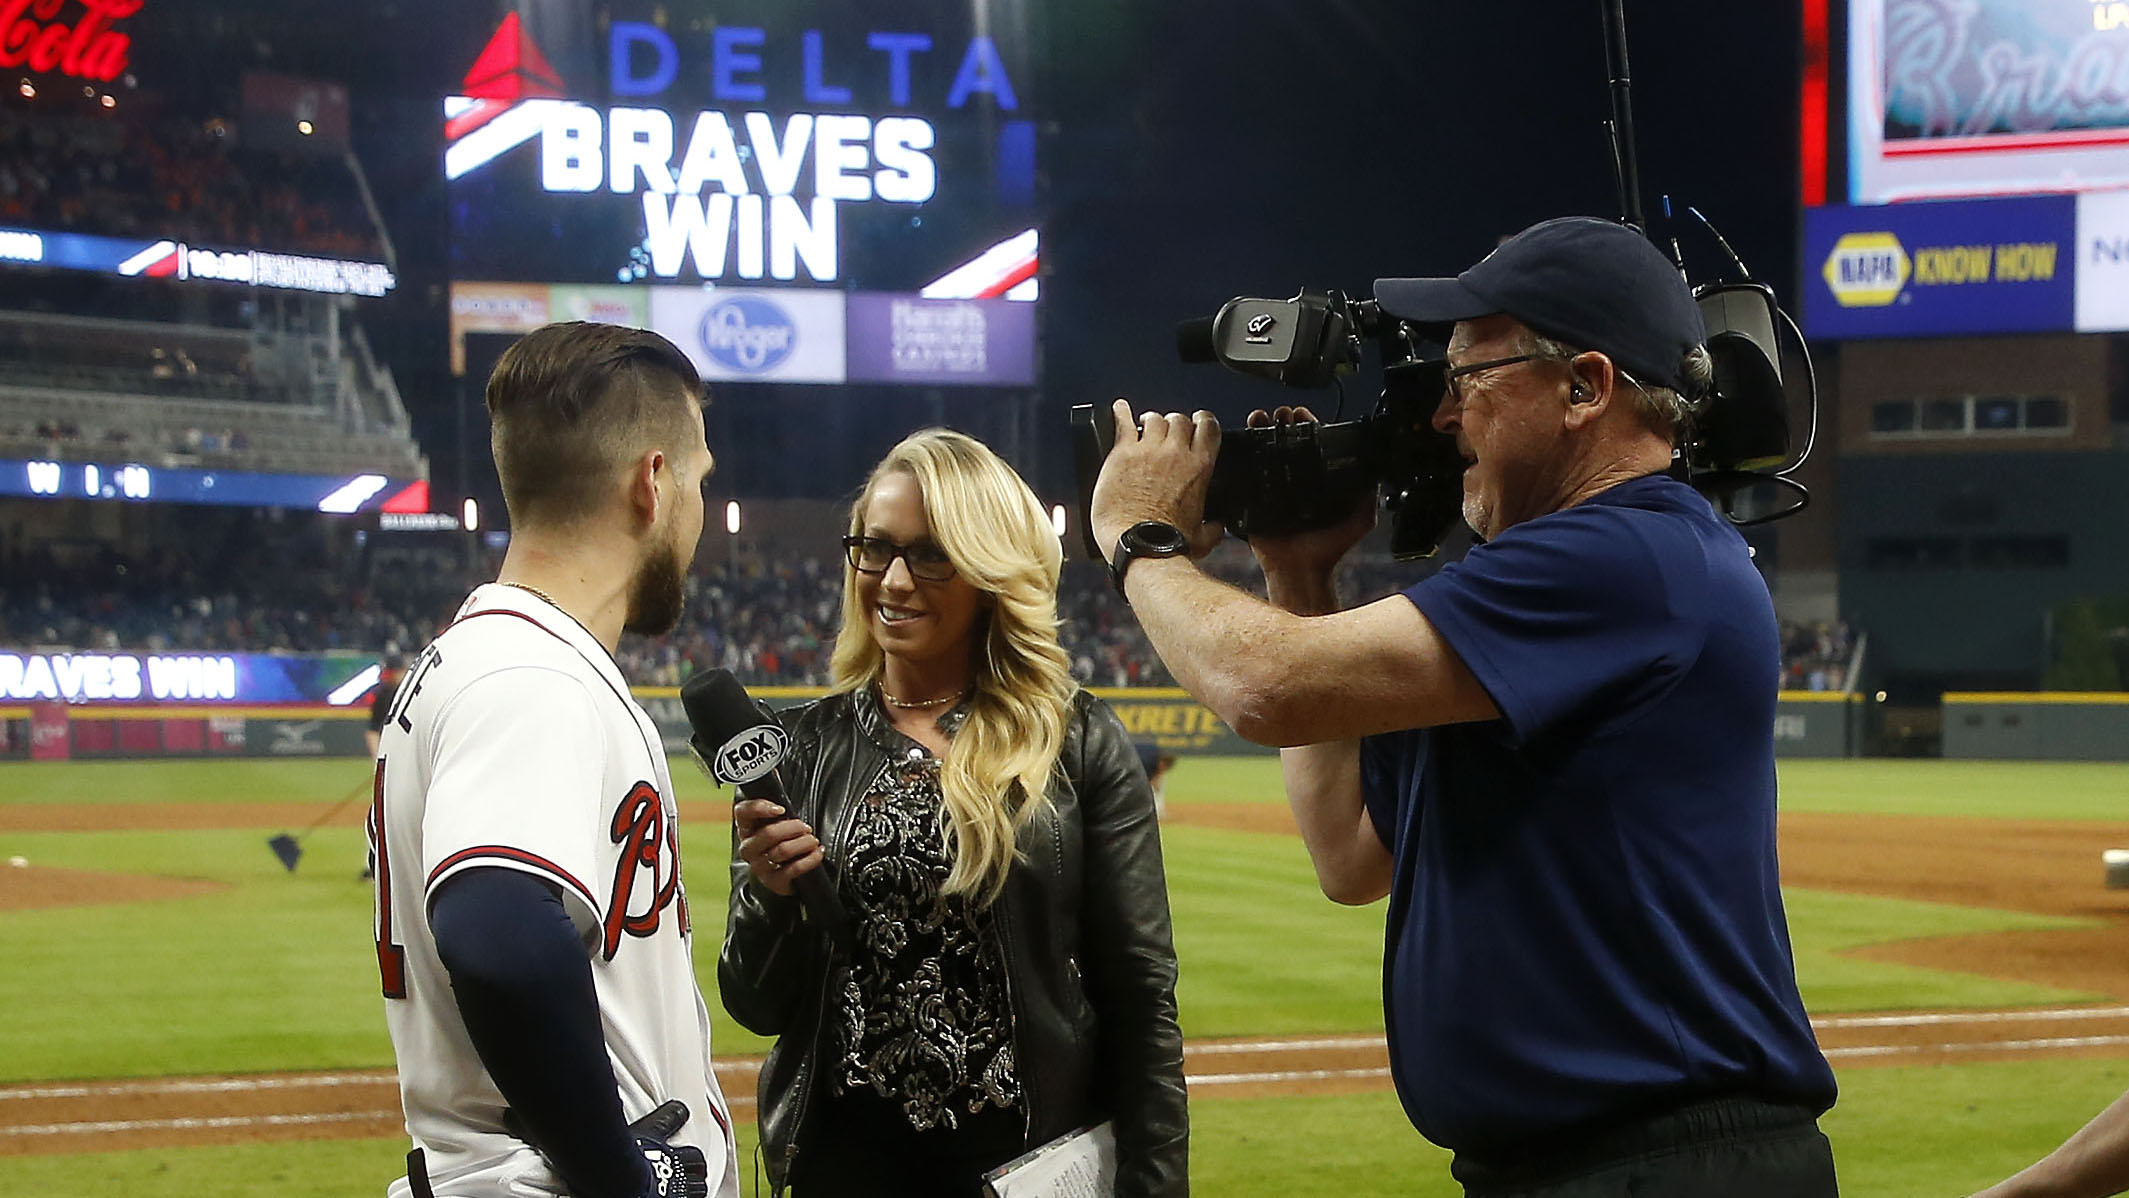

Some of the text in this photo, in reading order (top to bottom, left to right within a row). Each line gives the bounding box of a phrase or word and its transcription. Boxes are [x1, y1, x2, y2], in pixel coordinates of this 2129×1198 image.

[611, 21, 1019, 110] DELTA
[542, 107, 936, 202] BRAVES
[642, 193, 838, 281] WIN
[1913, 246, 1993, 285] KNOW
[1995, 242, 2058, 284] HOW
[706, 304, 790, 368] Kroger
[147, 656, 236, 699] WIN
[725, 732, 773, 771] FOX
[735, 748, 778, 778] SPORTS
